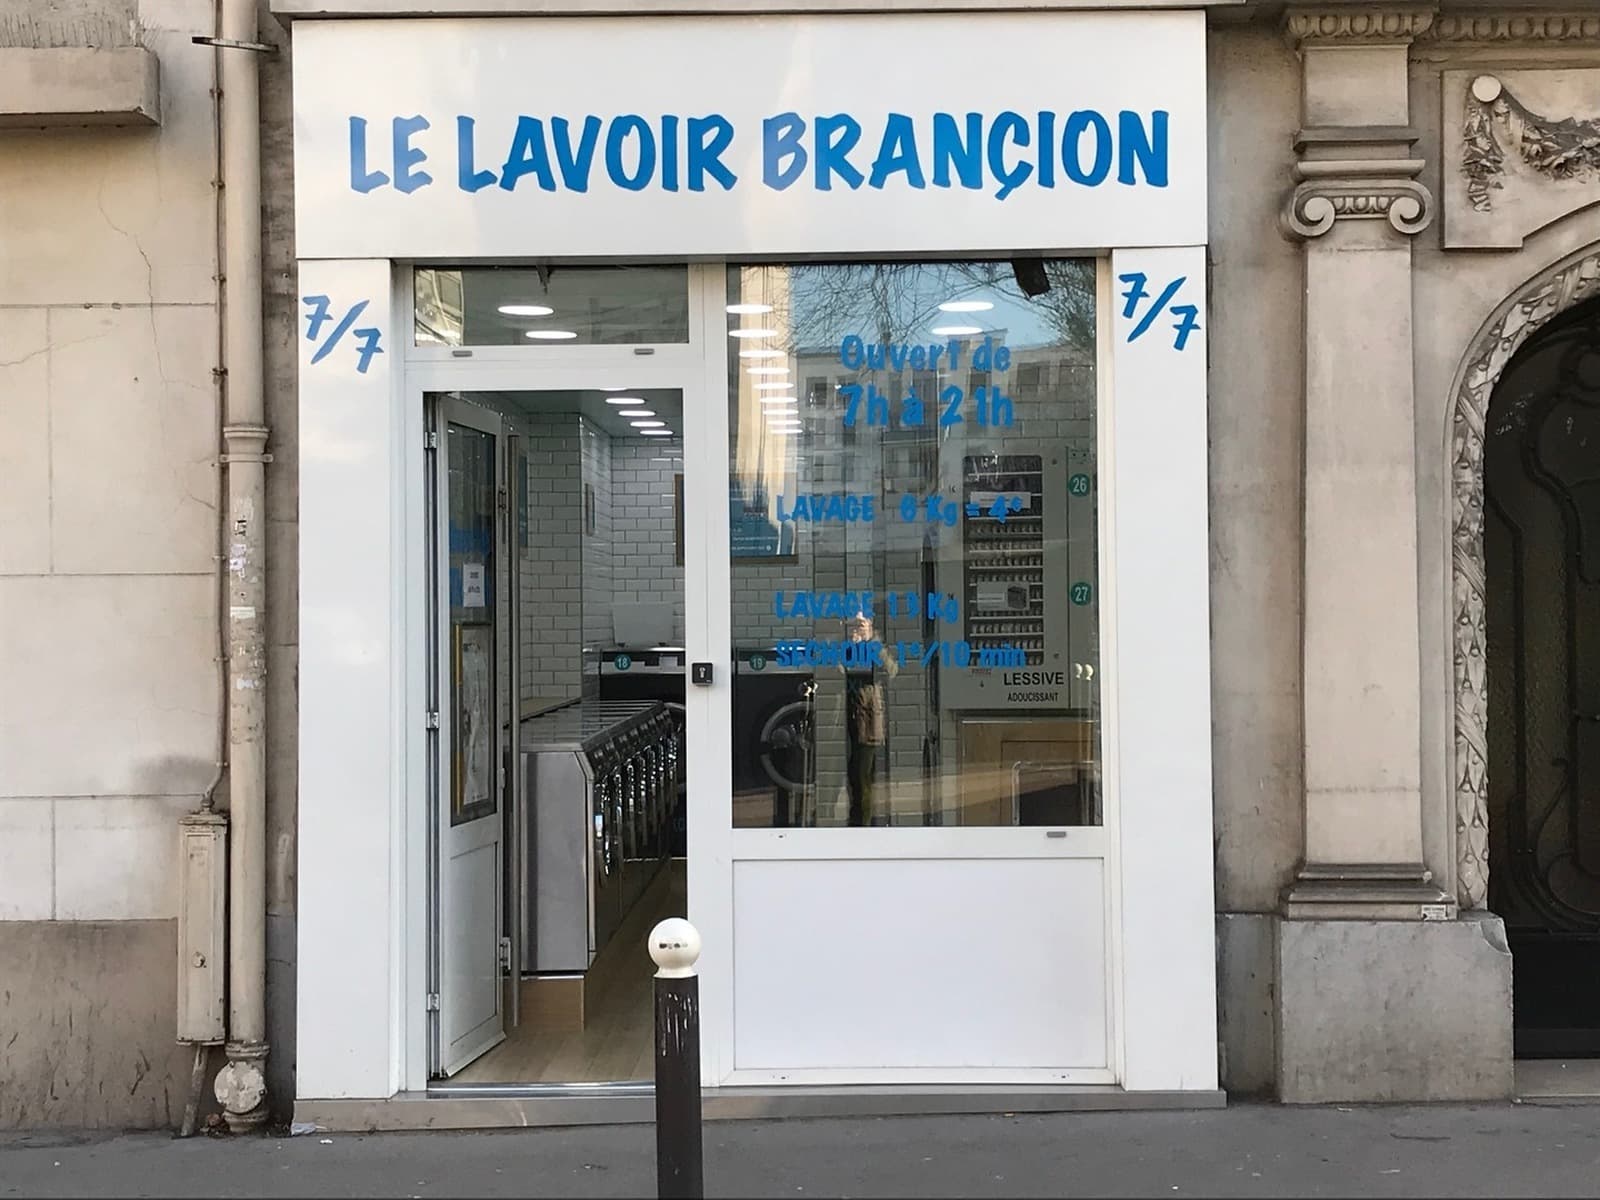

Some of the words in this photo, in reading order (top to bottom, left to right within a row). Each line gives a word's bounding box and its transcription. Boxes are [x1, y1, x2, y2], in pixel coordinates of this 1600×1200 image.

[350, 115, 432, 193] LE
[457, 113, 738, 193] LAVOIR
[762, 110, 1169, 201] BRANÇION
[1118, 272, 1203, 351] 7/7
[302, 294, 384, 374] 7/7
[840, 334, 962, 372] Ouvert
[972, 336, 1012, 372] de
[839, 384, 890, 427] 7h
[900, 386, 925, 426] à
[1072, 476, 1088, 493] 26
[776, 494, 875, 522] LAVAGE
[775, 590, 875, 620] LAVAGE
[1074, 586, 1088, 602] 27
[1003, 671, 1065, 686] LESSIVE
[1007, 692, 1059, 703] ADOUCISSANT
